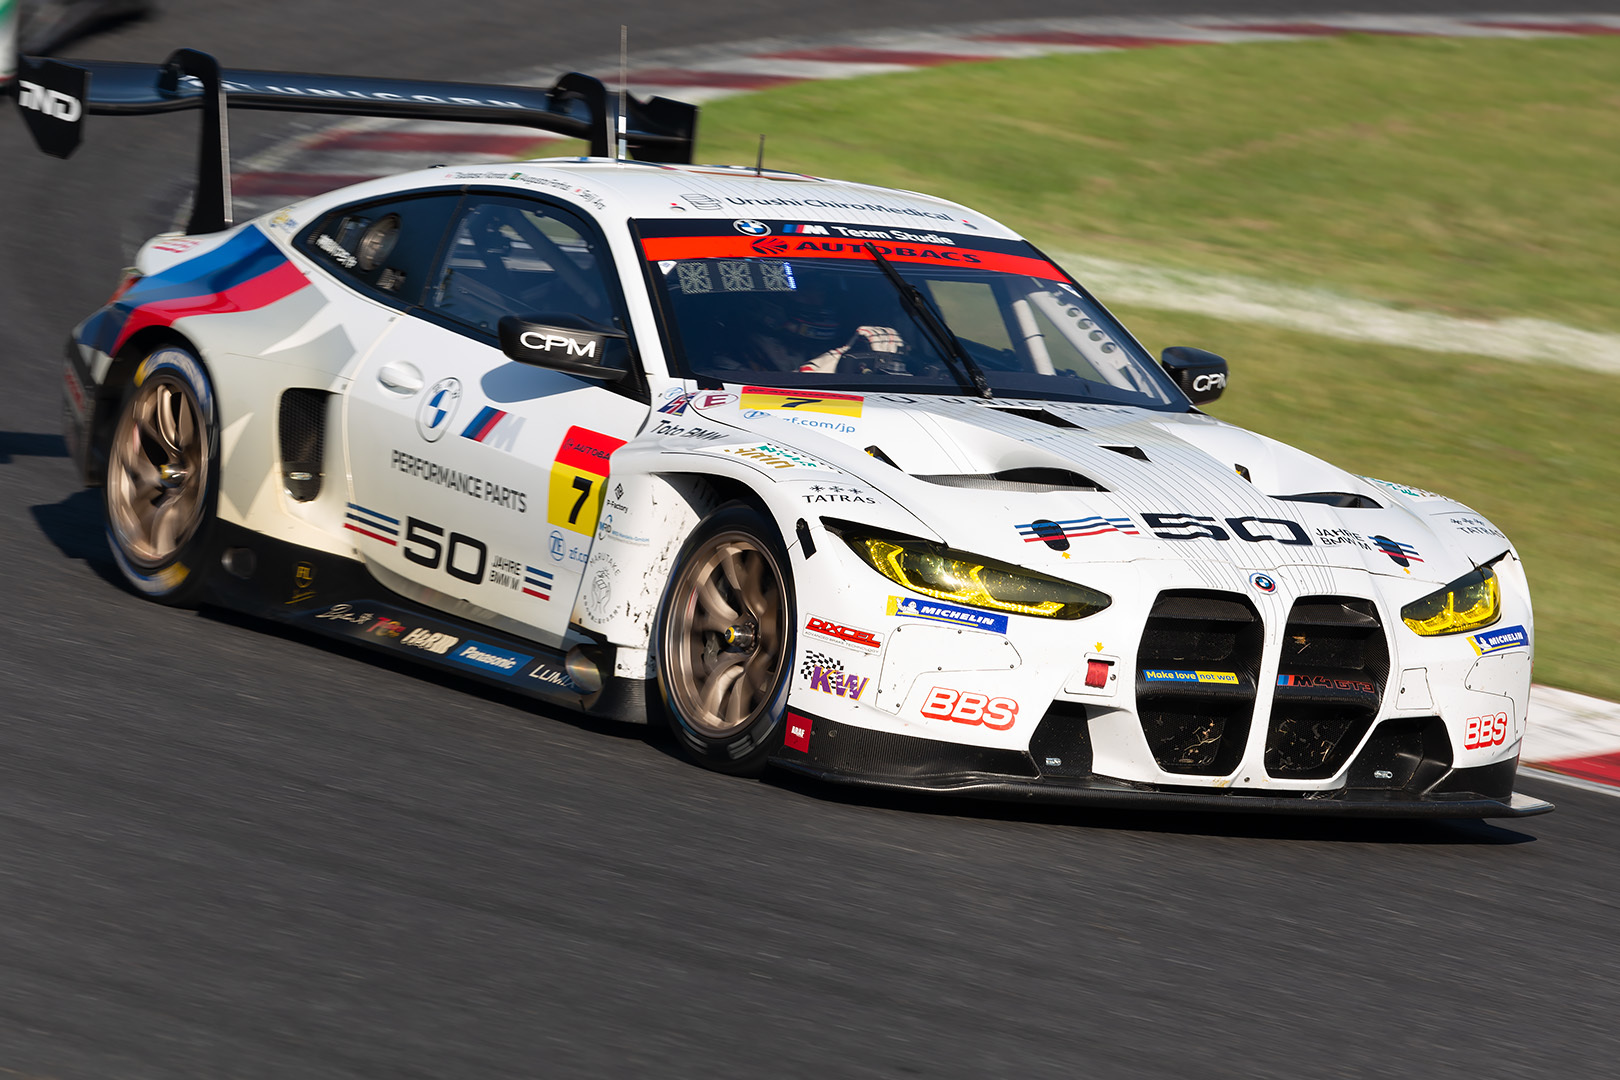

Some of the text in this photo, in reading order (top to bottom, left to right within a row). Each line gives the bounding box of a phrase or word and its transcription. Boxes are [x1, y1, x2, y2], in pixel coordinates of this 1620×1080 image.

[831, 225, 890, 240] Team
[890, 229, 956, 246] Studie
[793, 241, 982, 264] AUTOBACS
[519, 331, 597, 358] CPM
[780, 397, 824, 408] 7
[650, 419, 730, 441] Toto BMW
[390, 449, 527, 513] PERFORMANCE PARTS
[567, 475, 594, 525] 7
[801, 494, 876, 505] TATRAS
[1140, 512, 1314, 546] 50
[1315, 527, 1362, 543] JAHRE
[403, 515, 488, 585] 50
[1320, 536, 1372, 551] BMW M
[491, 555, 522, 576] JAHRE
[489, 569, 509, 588] BMW
[920, 605, 995, 626] MICHELIN
[805, 617, 882, 649] DIXCEL
[1488, 631, 1524, 646] MICHELIN
[459, 646, 518, 670] Panasonic
[809, 664, 870, 701] KW
[1146, 670, 1196, 680] Make love
[1199, 672, 1215, 682] not
[919, 686, 1020, 731] BBS
[1464, 711, 1508, 751] BBS
